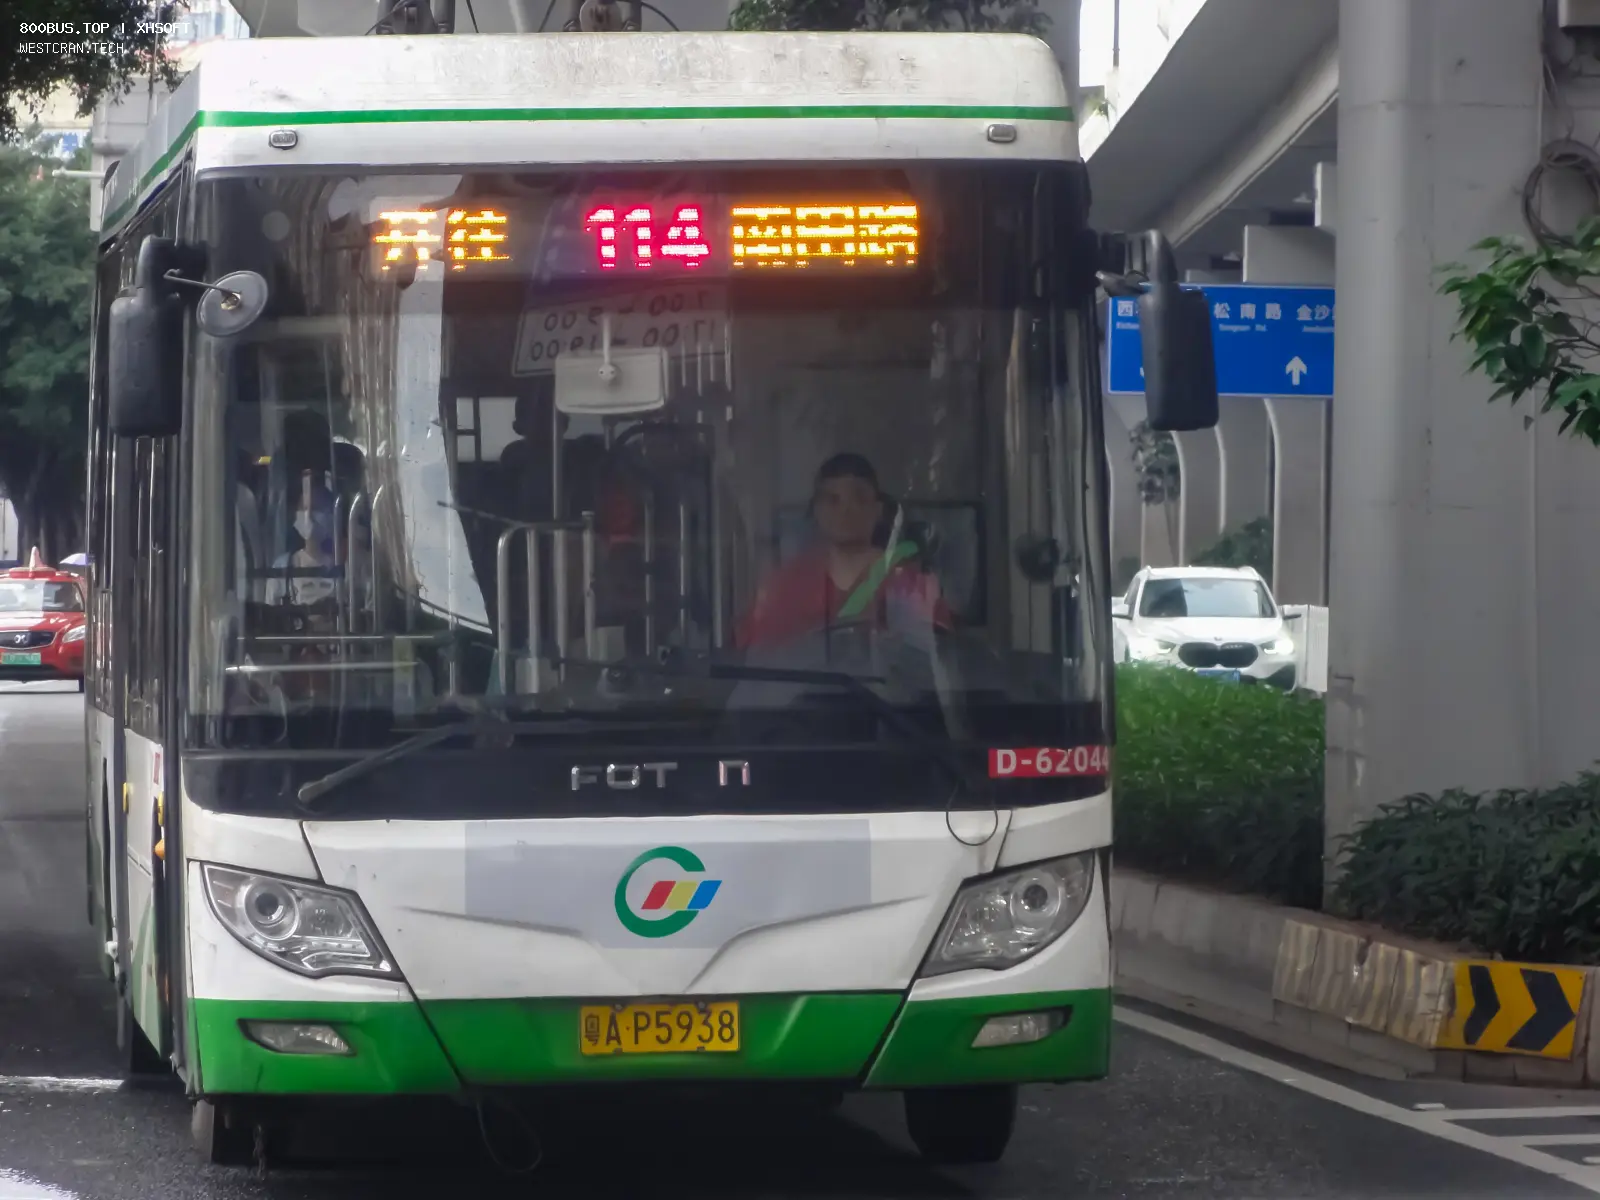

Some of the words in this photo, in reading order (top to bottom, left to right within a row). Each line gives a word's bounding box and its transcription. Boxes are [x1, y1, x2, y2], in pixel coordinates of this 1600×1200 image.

[375, 210, 510, 270] 开往
[585, 207, 709, 267] 114
[1296, 303, 1335, 320] 金沙
[997, 745, 1109, 774] D-62044
